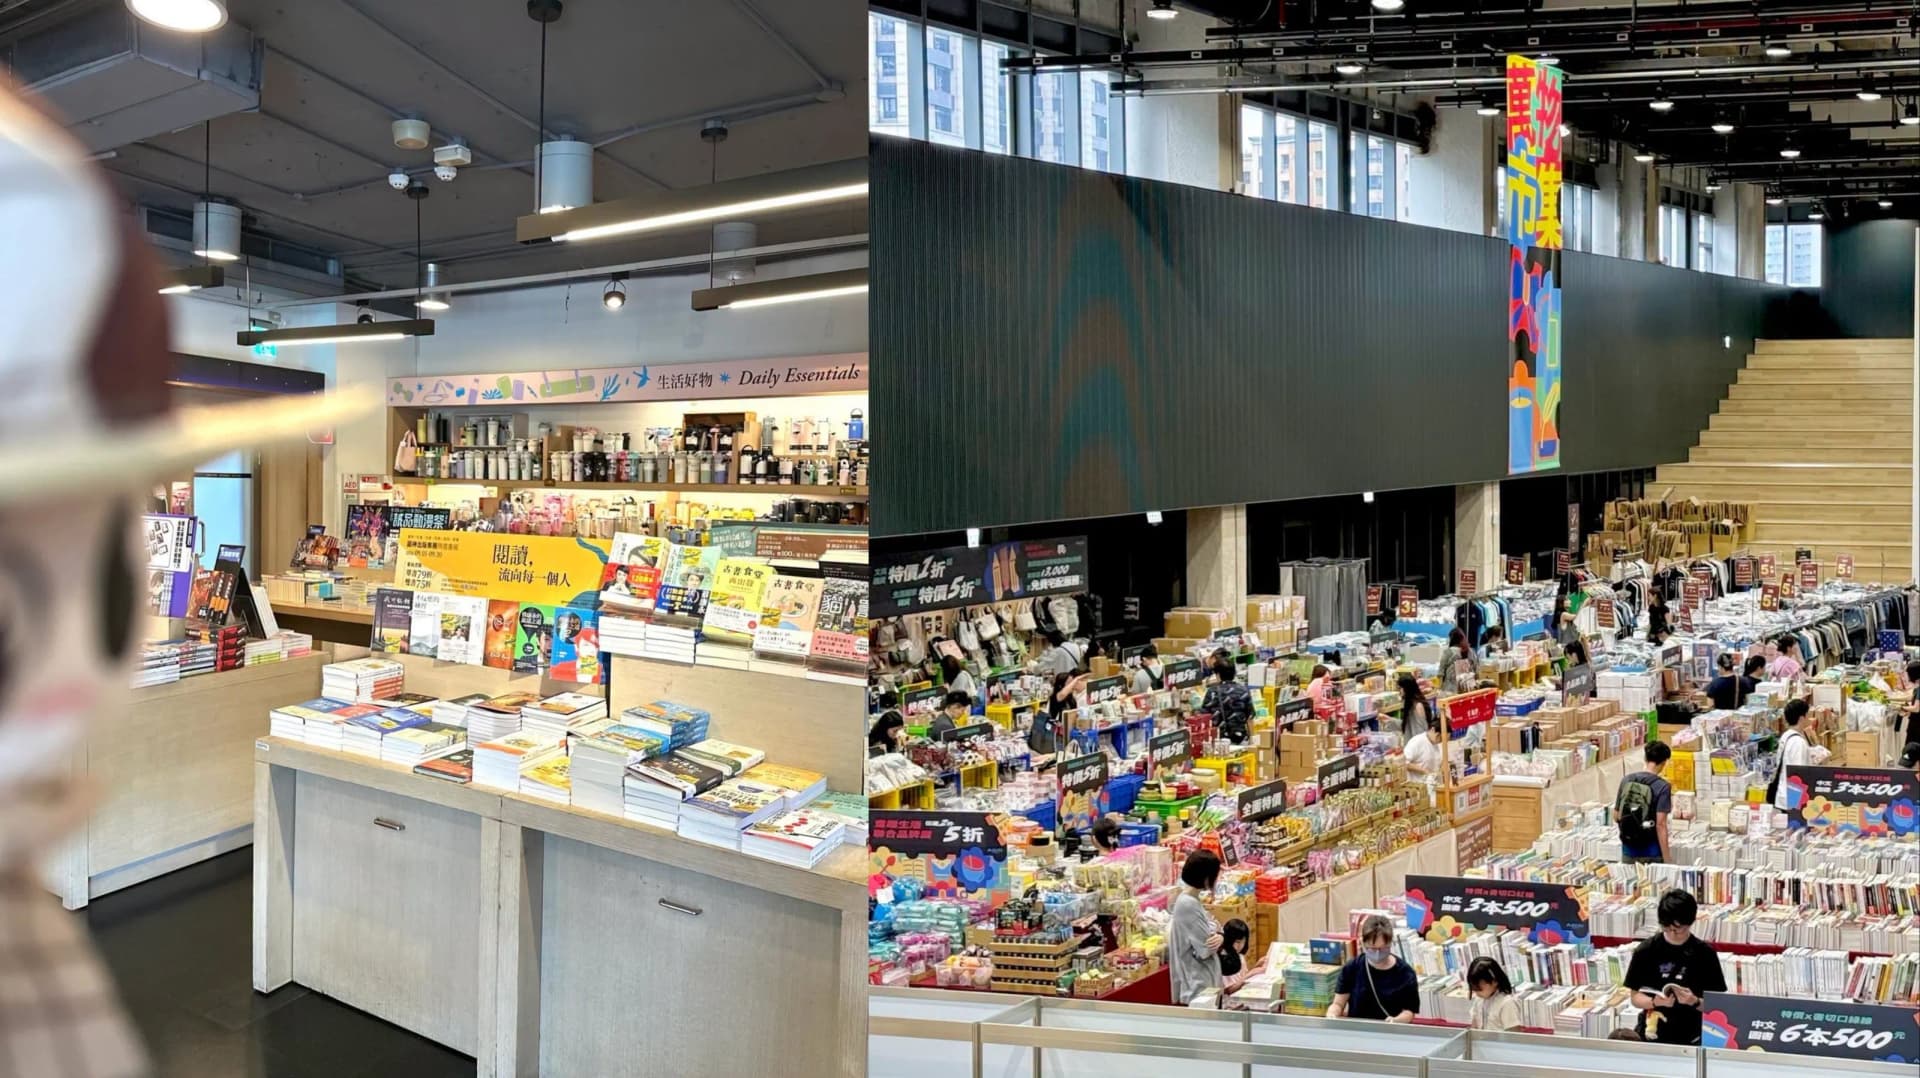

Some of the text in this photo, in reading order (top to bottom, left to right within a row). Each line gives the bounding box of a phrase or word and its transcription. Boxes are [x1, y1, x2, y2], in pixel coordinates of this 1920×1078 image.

[657, 372, 713, 390] 生活好物
[738, 363, 861, 388] Daily Essentials
[498, 567, 572, 588] 流向每一個人
[722, 564, 764, 580] 古書食堂
[773, 579, 815, 593] 古書食堂
[1062, 765, 1102, 787] 特價5折
[1242, 791, 1282, 817] 全面特價
[942, 826, 985, 844] 5折
[1442, 895, 1463, 904] 中文
[1751, 1019, 1778, 1031] 中文
[1748, 1030, 1774, 1041] 圖書
